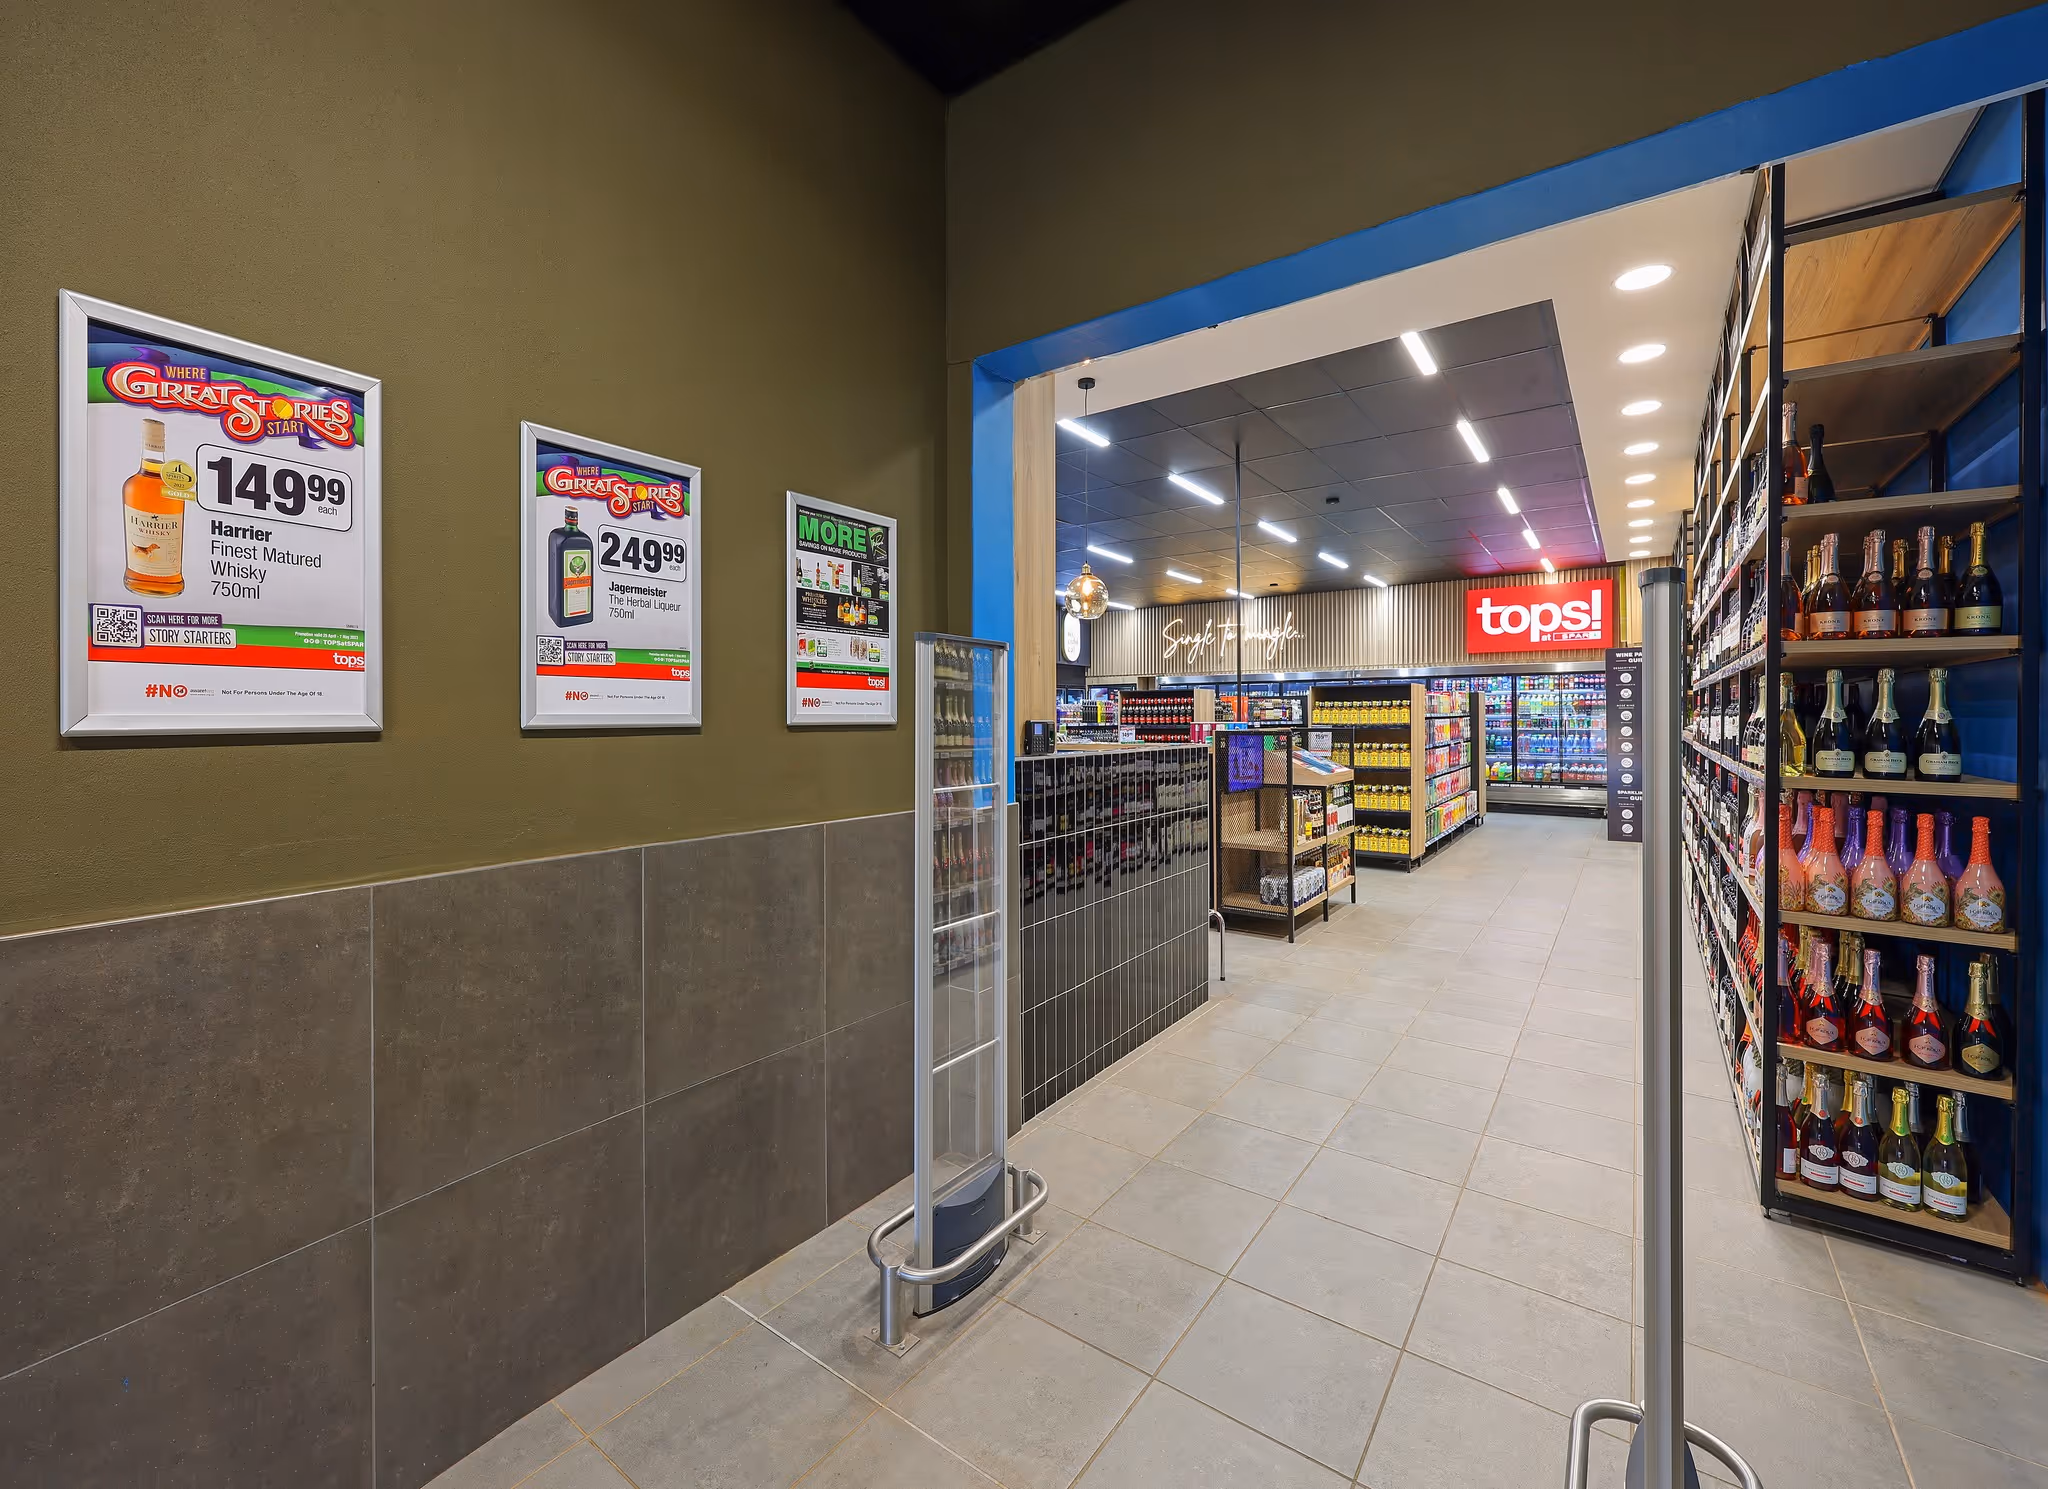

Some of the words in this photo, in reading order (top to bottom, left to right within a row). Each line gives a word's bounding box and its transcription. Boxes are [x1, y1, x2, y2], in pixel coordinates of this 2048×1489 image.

[164, 366, 206, 379] WHERE
[112, 366, 242, 409] GREAT
[228, 395, 349, 441] STORIES
[267, 421, 305, 435] START
[576, 466, 599, 476] WHERE
[167, 490, 190, 498] GOLD
[548, 469, 619, 495] GREAT
[611, 484, 681, 514] STORIES
[318, 505, 338, 516] each
[632, 501, 654, 512] START
[130, 515, 178, 530] HARRIER
[138, 527, 171, 536] WHISKY
[211, 520, 272, 542] Harrier
[799, 515, 867, 553] MORE
[211, 540, 257, 560] Finest
[263, 546, 322, 568] Matured
[799, 540, 820, 550] SAVINGS
[828, 547, 842, 555] MORE
[843, 549, 868, 560] PRODUCTS!
[211, 560, 267, 583] Whisky
[211, 581, 260, 599] 750ml
[609, 581, 667, 598] Jagermeister
[609, 594, 624, 606] The
[627, 597, 651, 609] Herbal
[654, 600, 681, 612] Liqueur
[147, 614, 166, 624] SCAN
[168, 615, 185, 625] HERE
[187, 616, 200, 625] FOR
[201, 615, 219, 625] MORE
[609, 607, 635, 619] 750ml
[1476, 589, 1602, 642] tops!
[149, 629, 180, 643] STORY
[183, 630, 231, 645] STARTERS
[1163, 618, 1216, 664] Single
[1217, 617, 1245, 657] to
[1541, 632, 1552, 641] at
[568, 651, 584, 662] STORY
[586, 652, 613, 663] STARTERS
